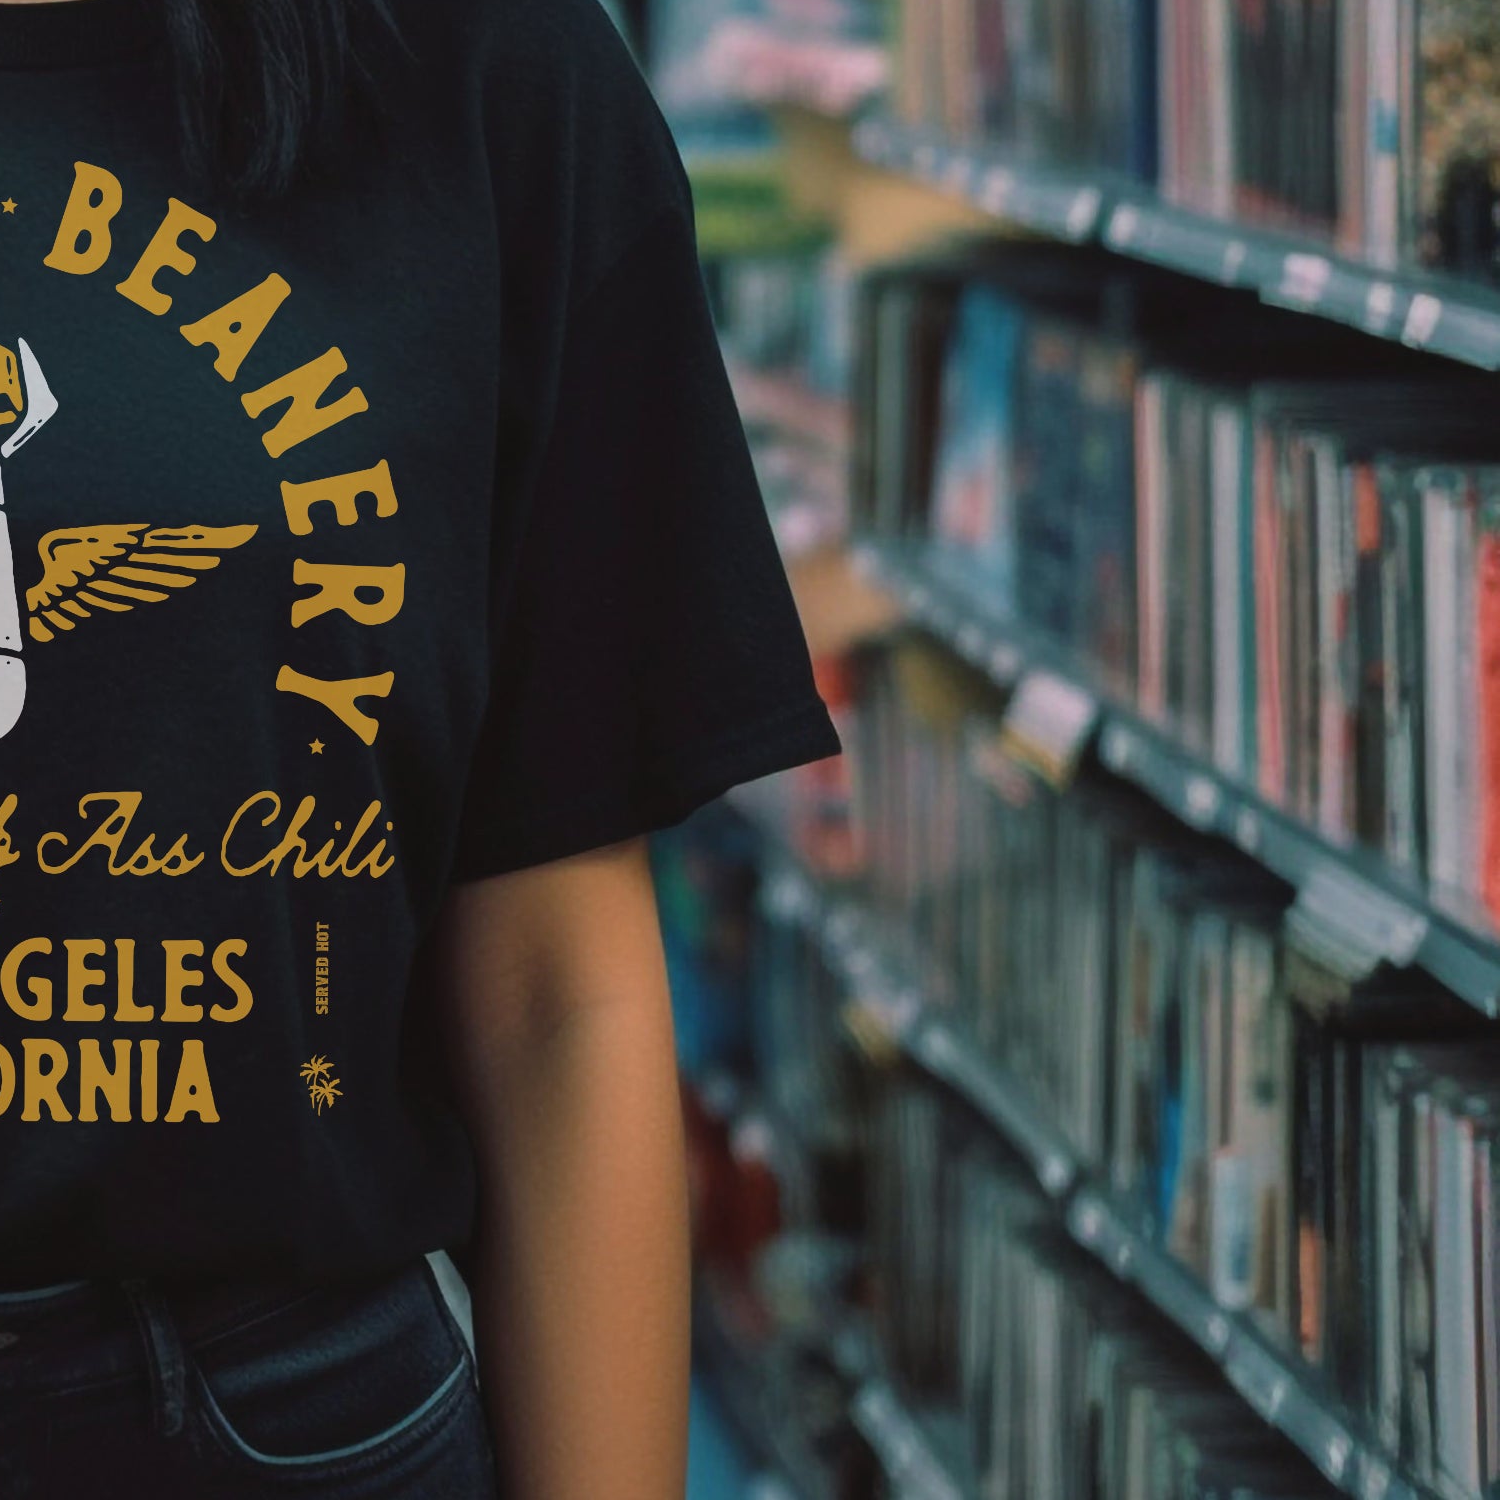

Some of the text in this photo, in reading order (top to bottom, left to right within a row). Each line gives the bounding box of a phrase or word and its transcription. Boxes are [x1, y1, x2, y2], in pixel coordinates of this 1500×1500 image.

[43, 161, 406, 746] BEANERY
[36, 791, 205, 877] Ass
[220, 790, 395, 879] Chili
[315, 921, 329, 1015] SERVED HOT
